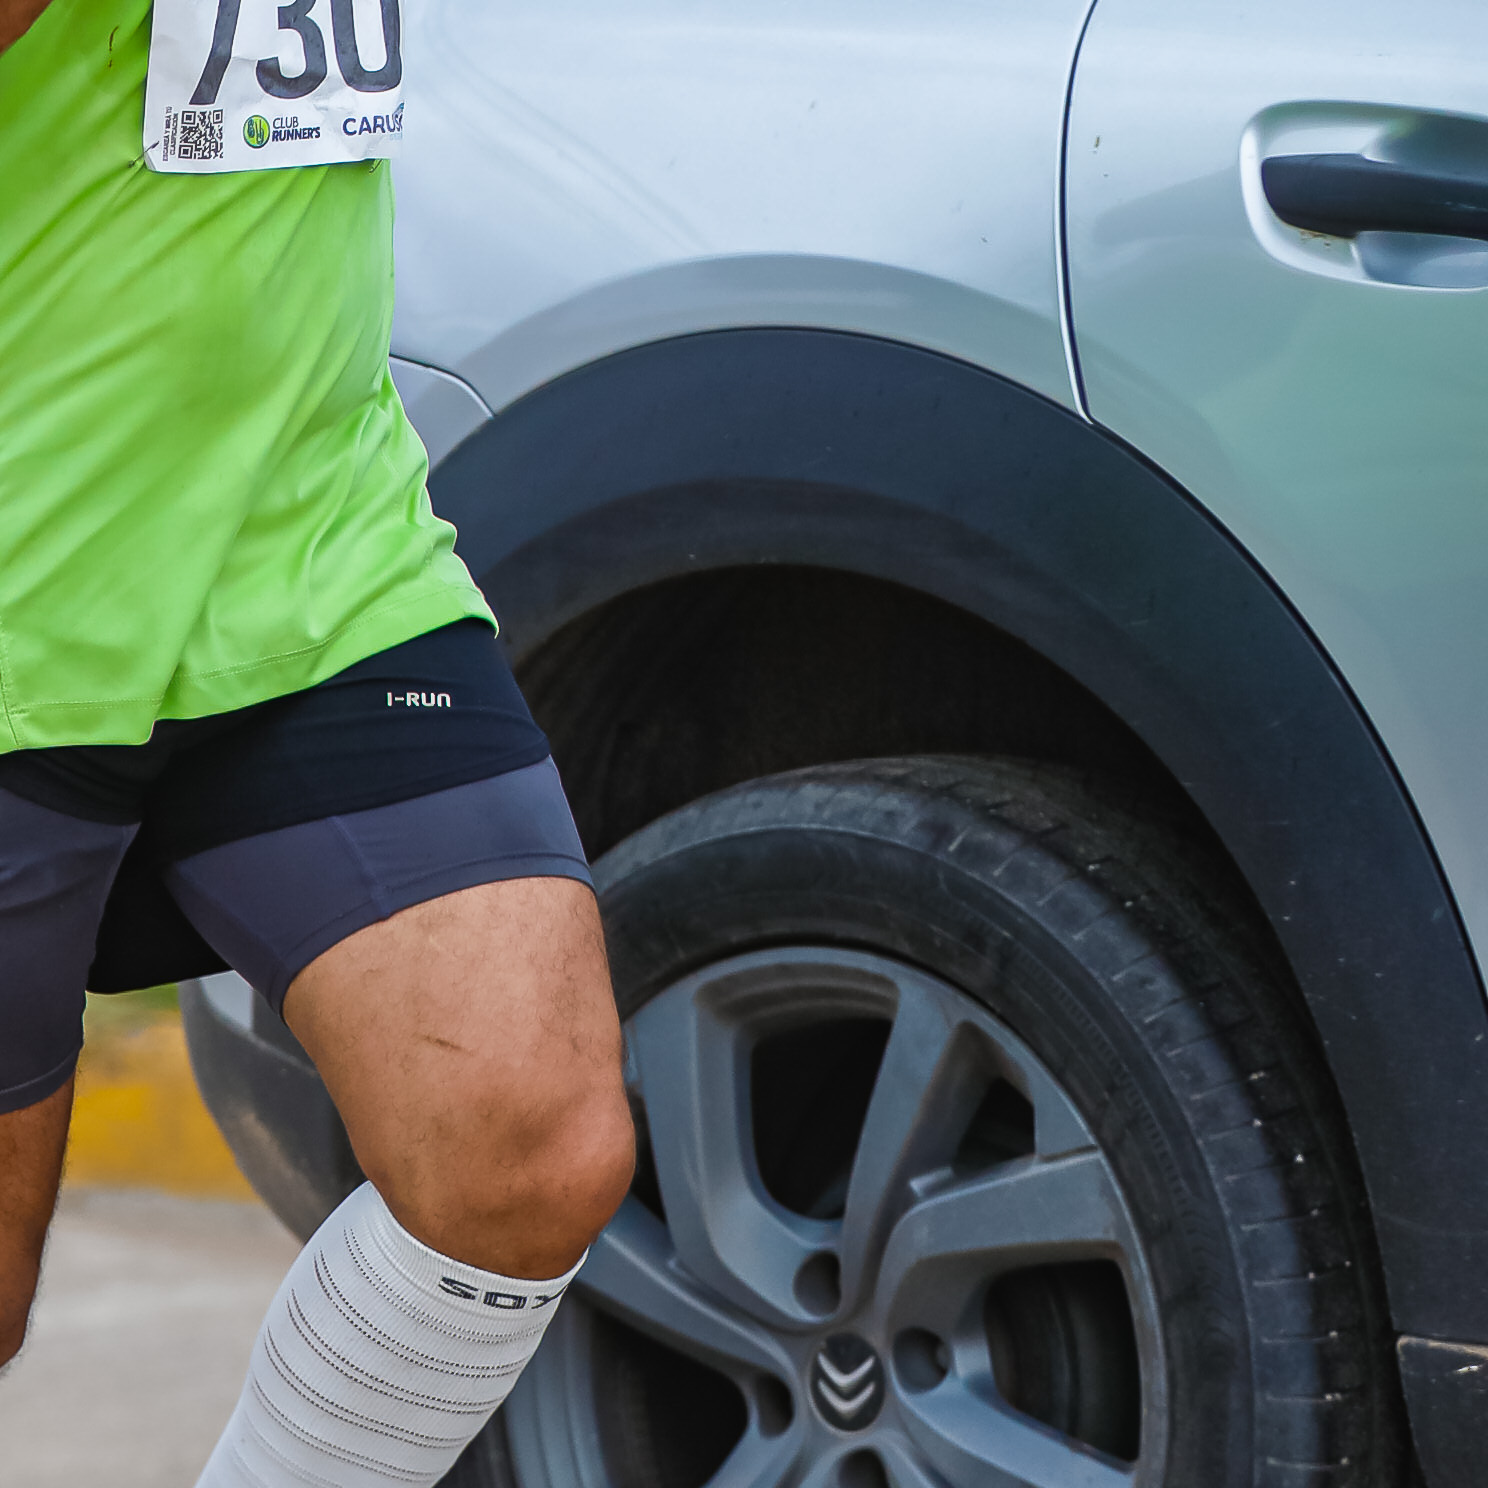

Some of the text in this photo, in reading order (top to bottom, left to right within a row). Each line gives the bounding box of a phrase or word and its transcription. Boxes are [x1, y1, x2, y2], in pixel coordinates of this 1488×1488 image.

[272, 116, 299, 130] CLUB
[272, 126, 321, 142] RUNNER'S
[387, 692, 451, 708] I-RUN
